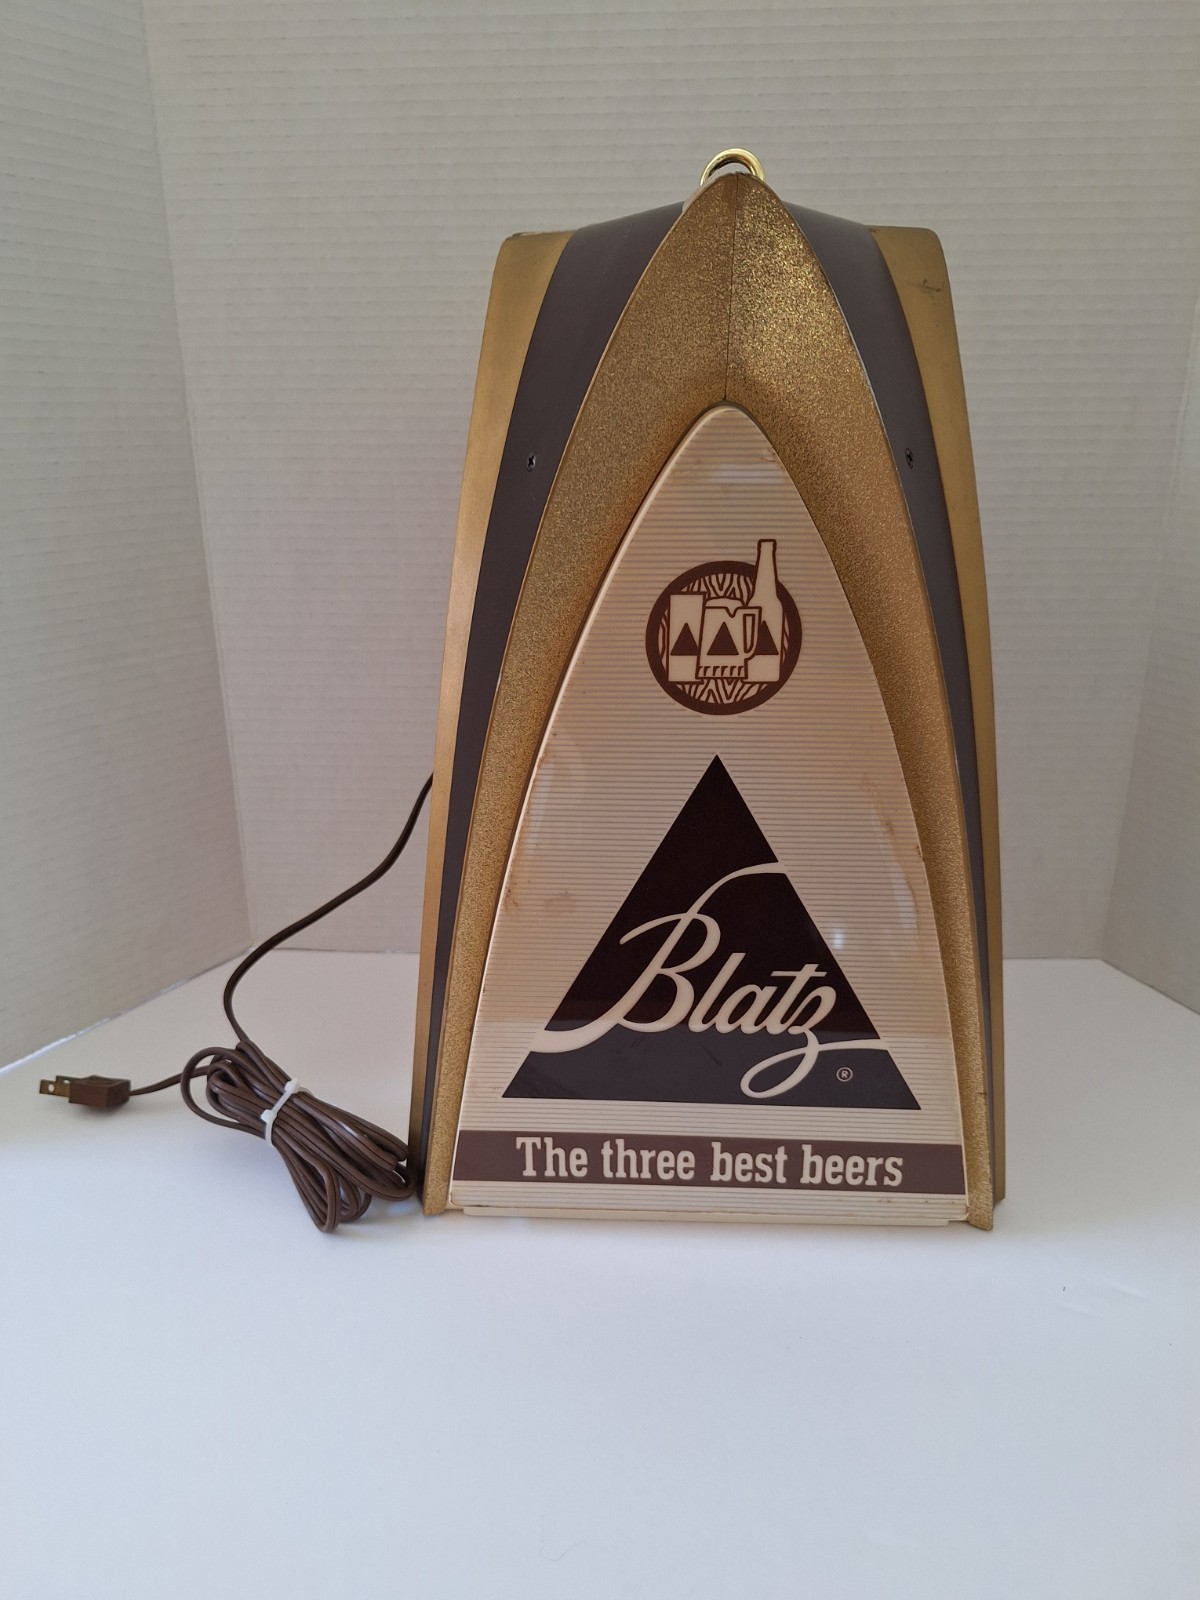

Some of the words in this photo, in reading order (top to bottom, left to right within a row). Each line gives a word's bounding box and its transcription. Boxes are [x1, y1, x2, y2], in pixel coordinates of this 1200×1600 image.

[530, 861, 889, 1099] Blatz
[515, 1136, 588, 1178] The
[600, 1138, 696, 1181] three
[710, 1141, 788, 1185] best
[799, 1143, 904, 1188] beers
